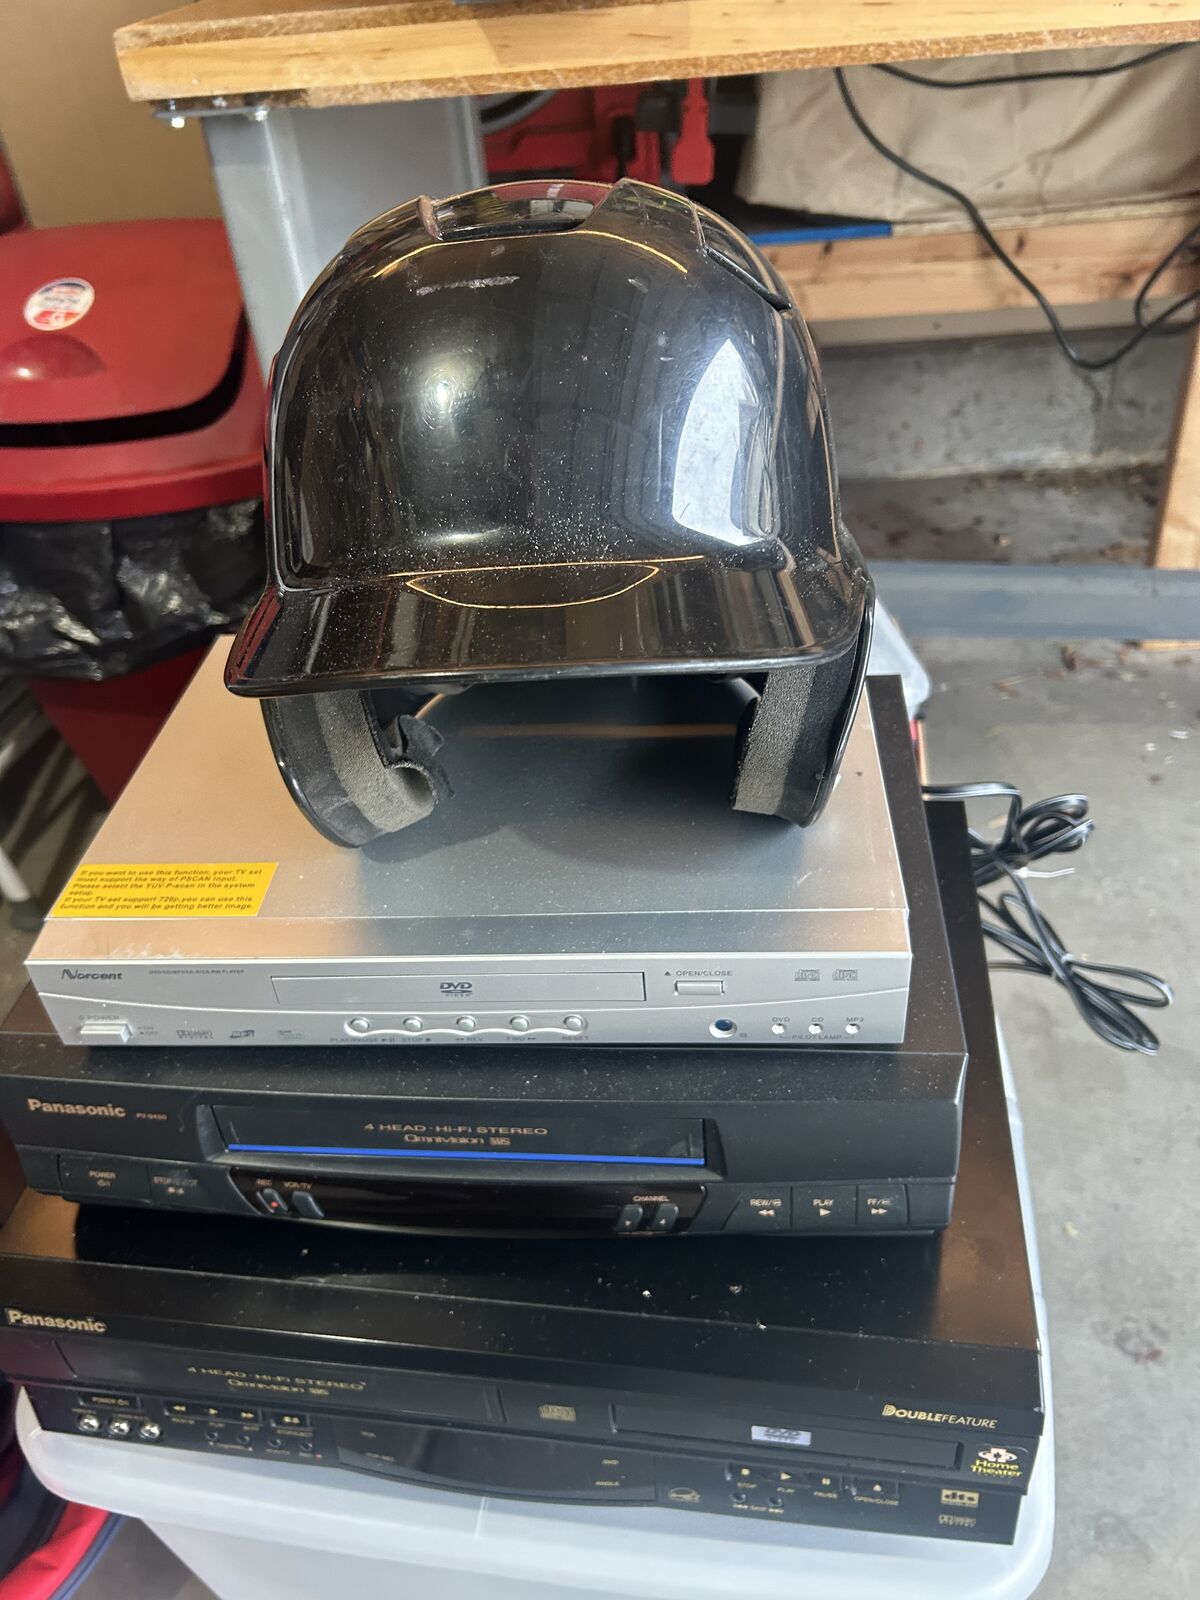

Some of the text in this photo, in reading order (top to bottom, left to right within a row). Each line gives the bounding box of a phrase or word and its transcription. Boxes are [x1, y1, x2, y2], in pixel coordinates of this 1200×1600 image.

[61, 968, 123, 980] Norcent
[675, 969, 733, 977] OPEN/CLOSE
[439, 981, 473, 990] DVD
[27, 1098, 127, 1117] Panasonic
[364, 1123, 375, 1131] 4
[378, 1123, 427, 1132] HEAD
[476, 1126, 548, 1135] STEREO
[88, 1170, 116, 1179] POWER
[813, 1199, 834, 1207] PLAY
[7, 1309, 107, 1333] Panasonic
[199, 1367, 248, 1379] HEAD
[295, 1377, 364, 1390] STEREO
[970, 1464, 1023, 1477] Theater
[975, 1459, 1019, 1470] Home
